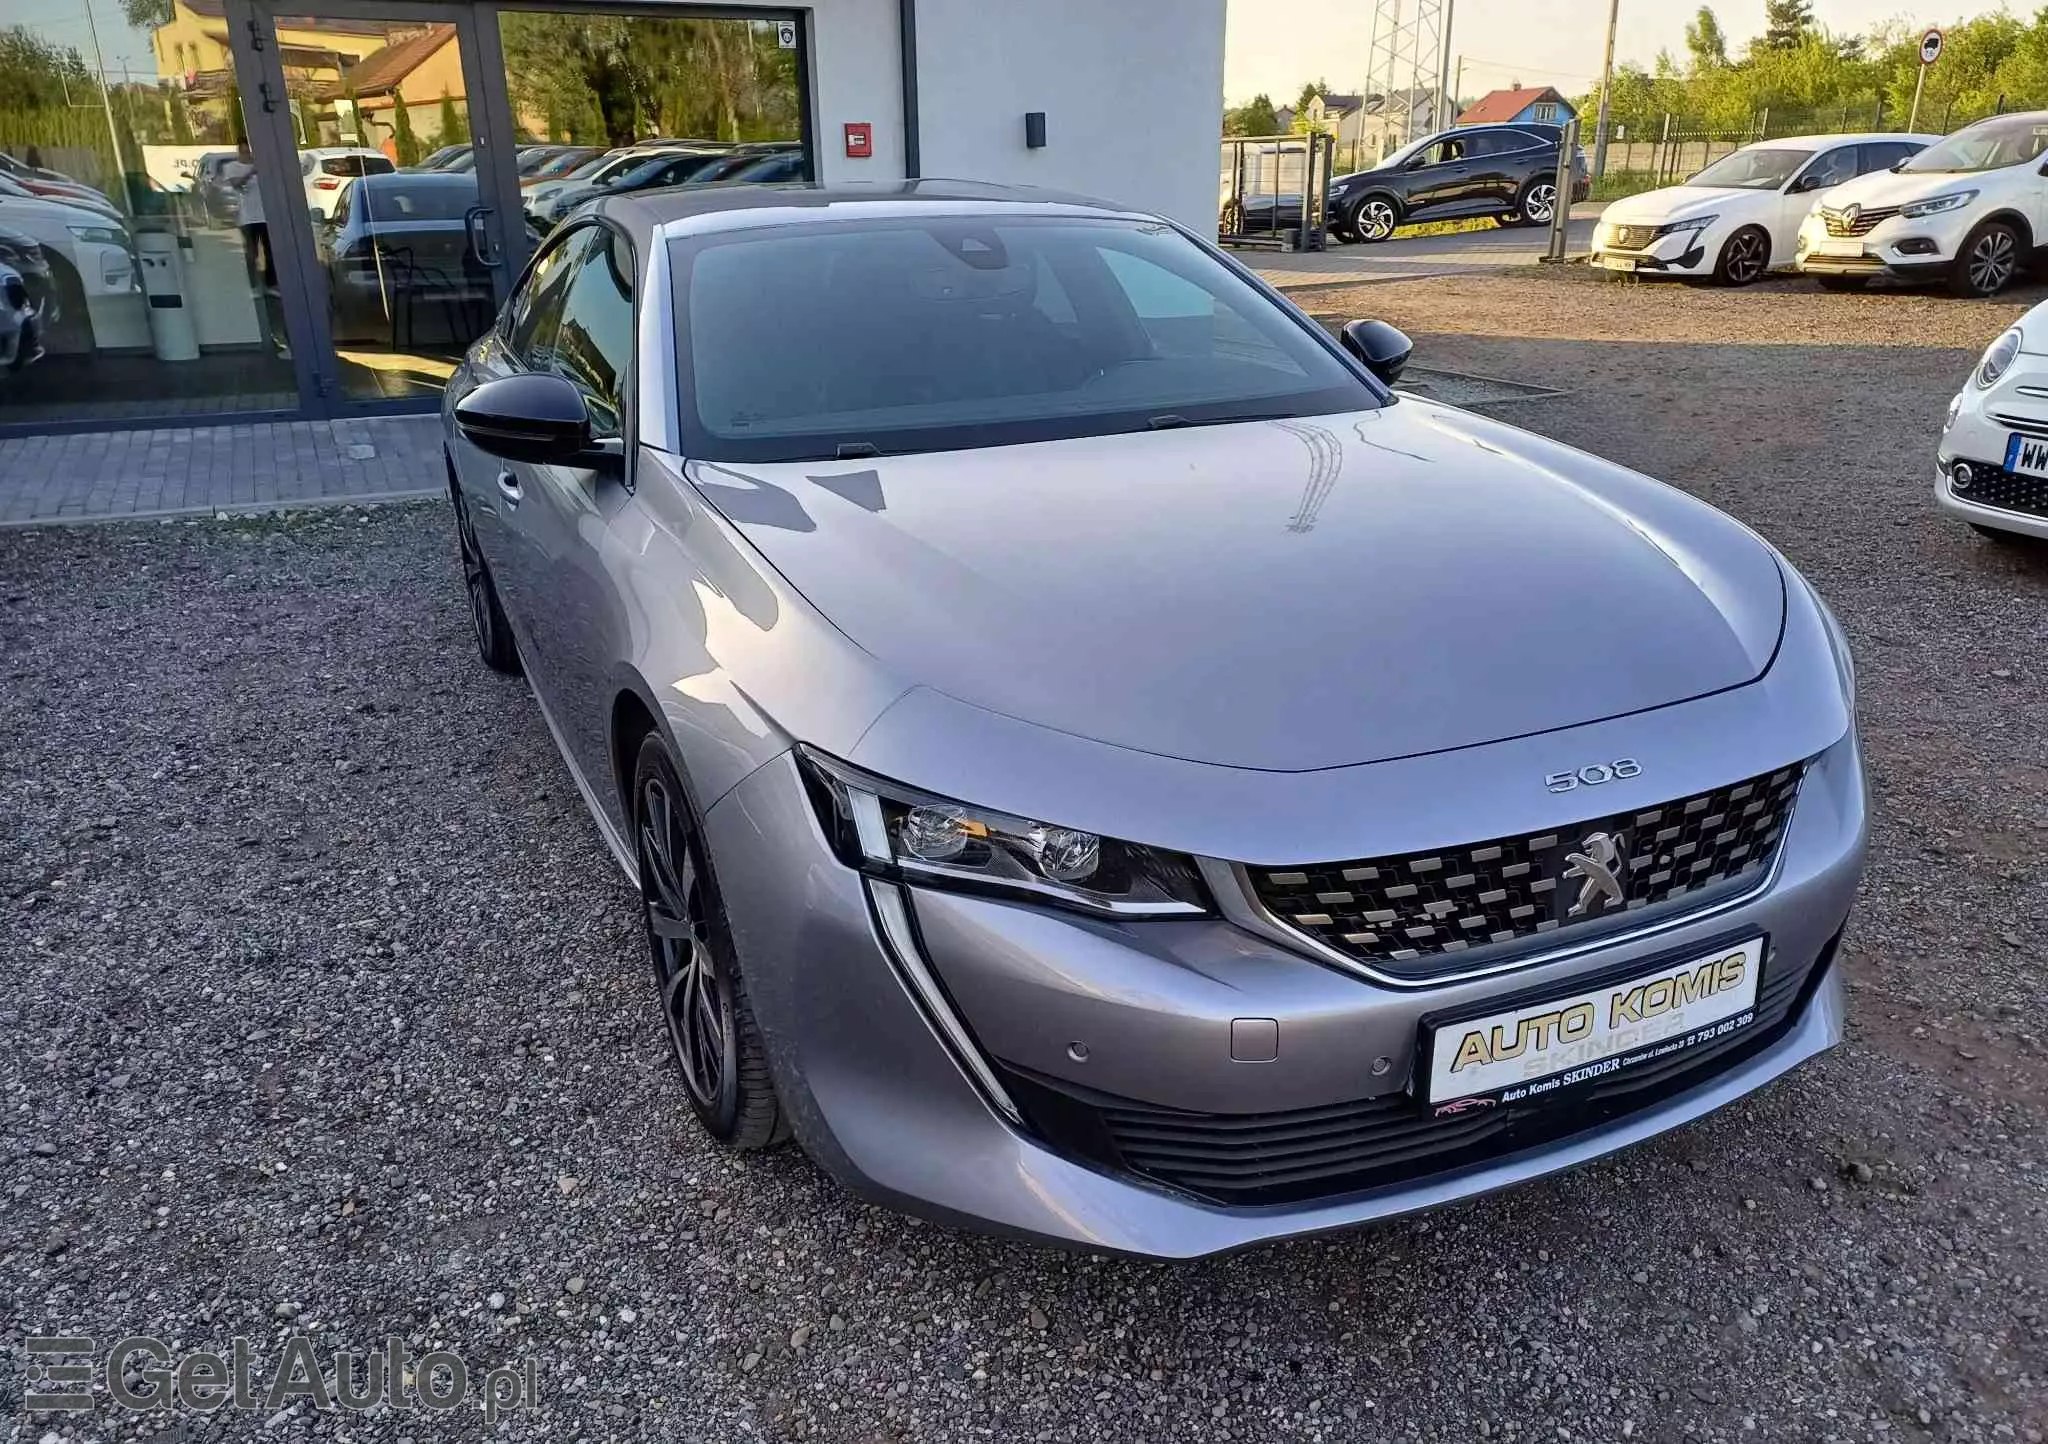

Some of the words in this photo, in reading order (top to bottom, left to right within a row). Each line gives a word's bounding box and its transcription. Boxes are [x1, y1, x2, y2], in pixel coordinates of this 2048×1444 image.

[1545, 758, 1641, 792] 508
[1450, 1001, 1595, 1073] AUTO
[1609, 951, 1746, 1030] KOMIS
[1502, 1088, 1527, 1103] Auto
[1529, 1079, 1560, 1095] Komis
[1563, 1058, 1620, 1086] SKINDER
[1697, 1027, 1715, 1042] 793
[1717, 1020, 1735, 1036] 002
[1736, 1012, 1753, 1028] 309
